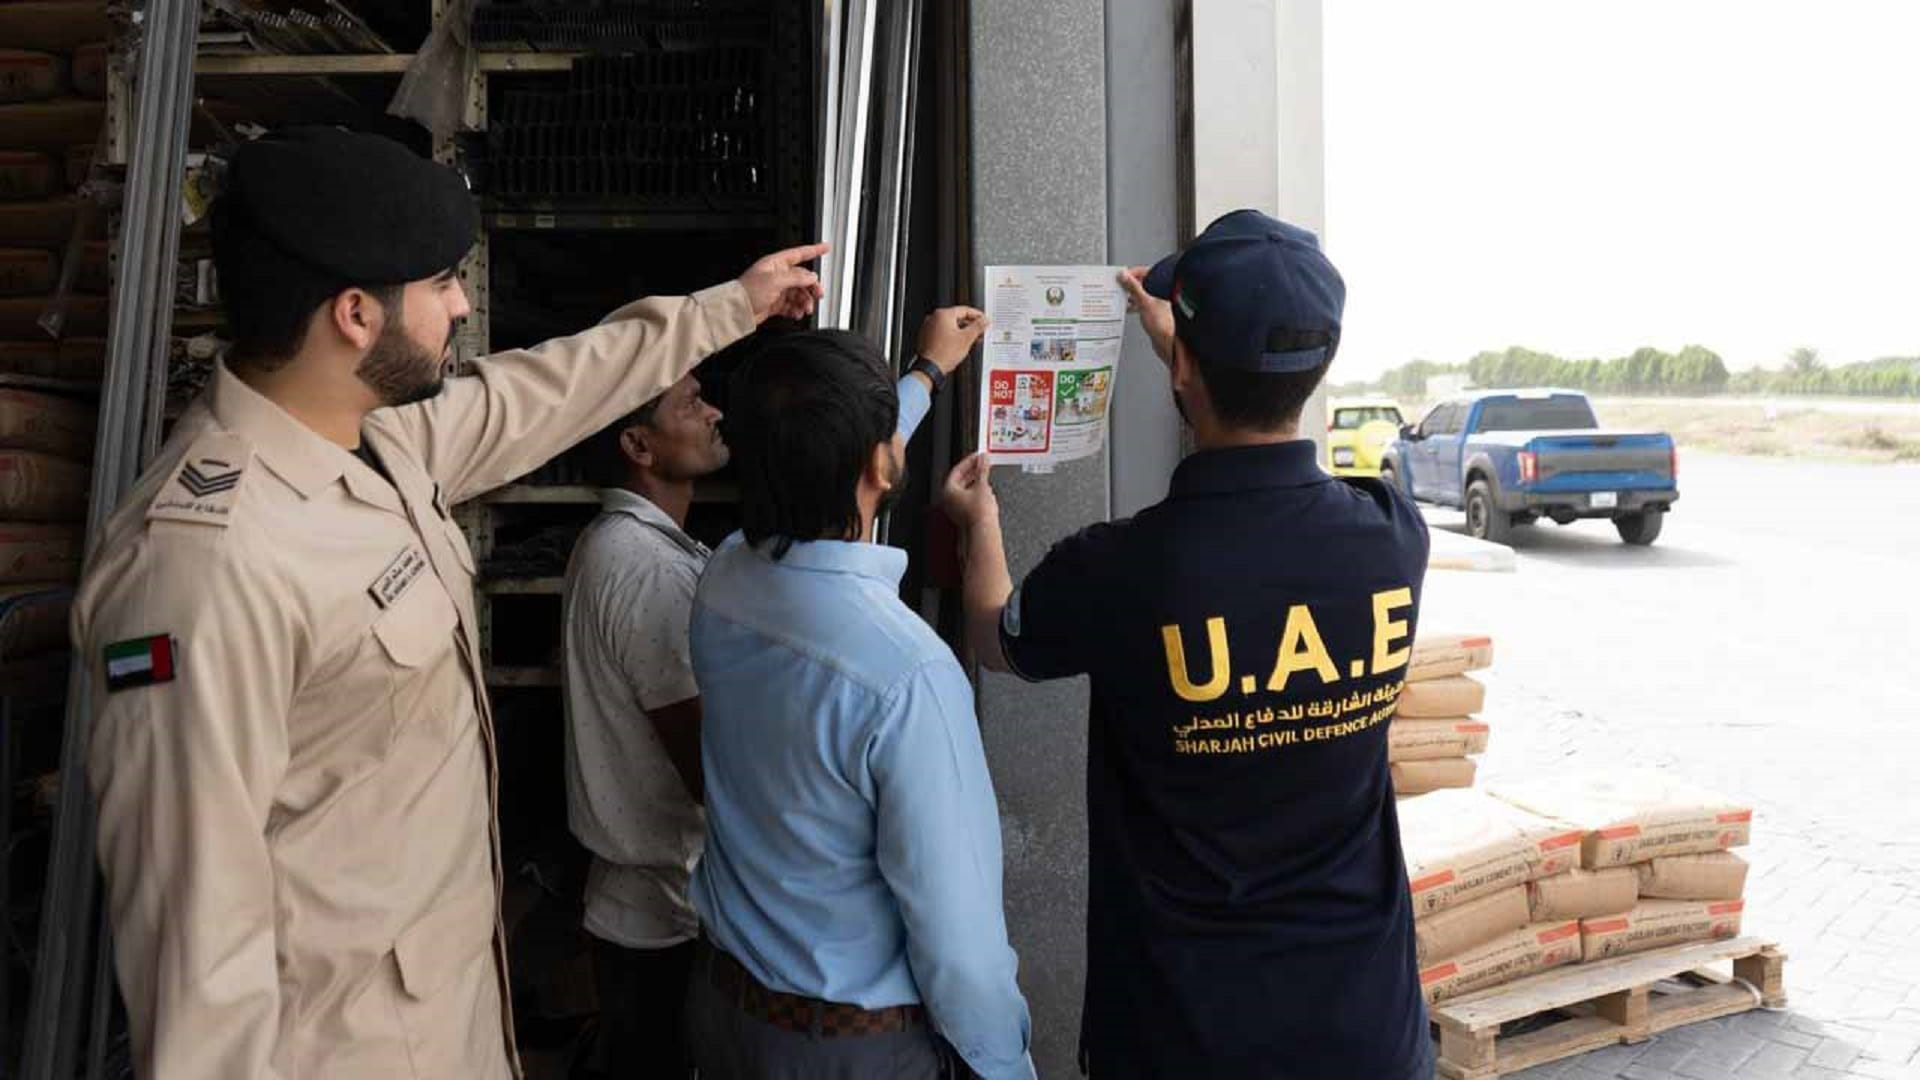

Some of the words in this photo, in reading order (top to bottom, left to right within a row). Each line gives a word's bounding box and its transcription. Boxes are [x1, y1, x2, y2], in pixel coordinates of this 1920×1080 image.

[994, 381, 1008, 390] DO
[1060, 374, 1075, 384] DO
[993, 390, 1013, 399] NOT
[1307, 690, 1371, 718] الشارقة
[1173, 713, 1240, 738] المدني
[1175, 734, 1255, 754] SHARJAH
[1258, 729, 1300, 748] CIVIL
[1303, 717, 1368, 742] DEFENCE
